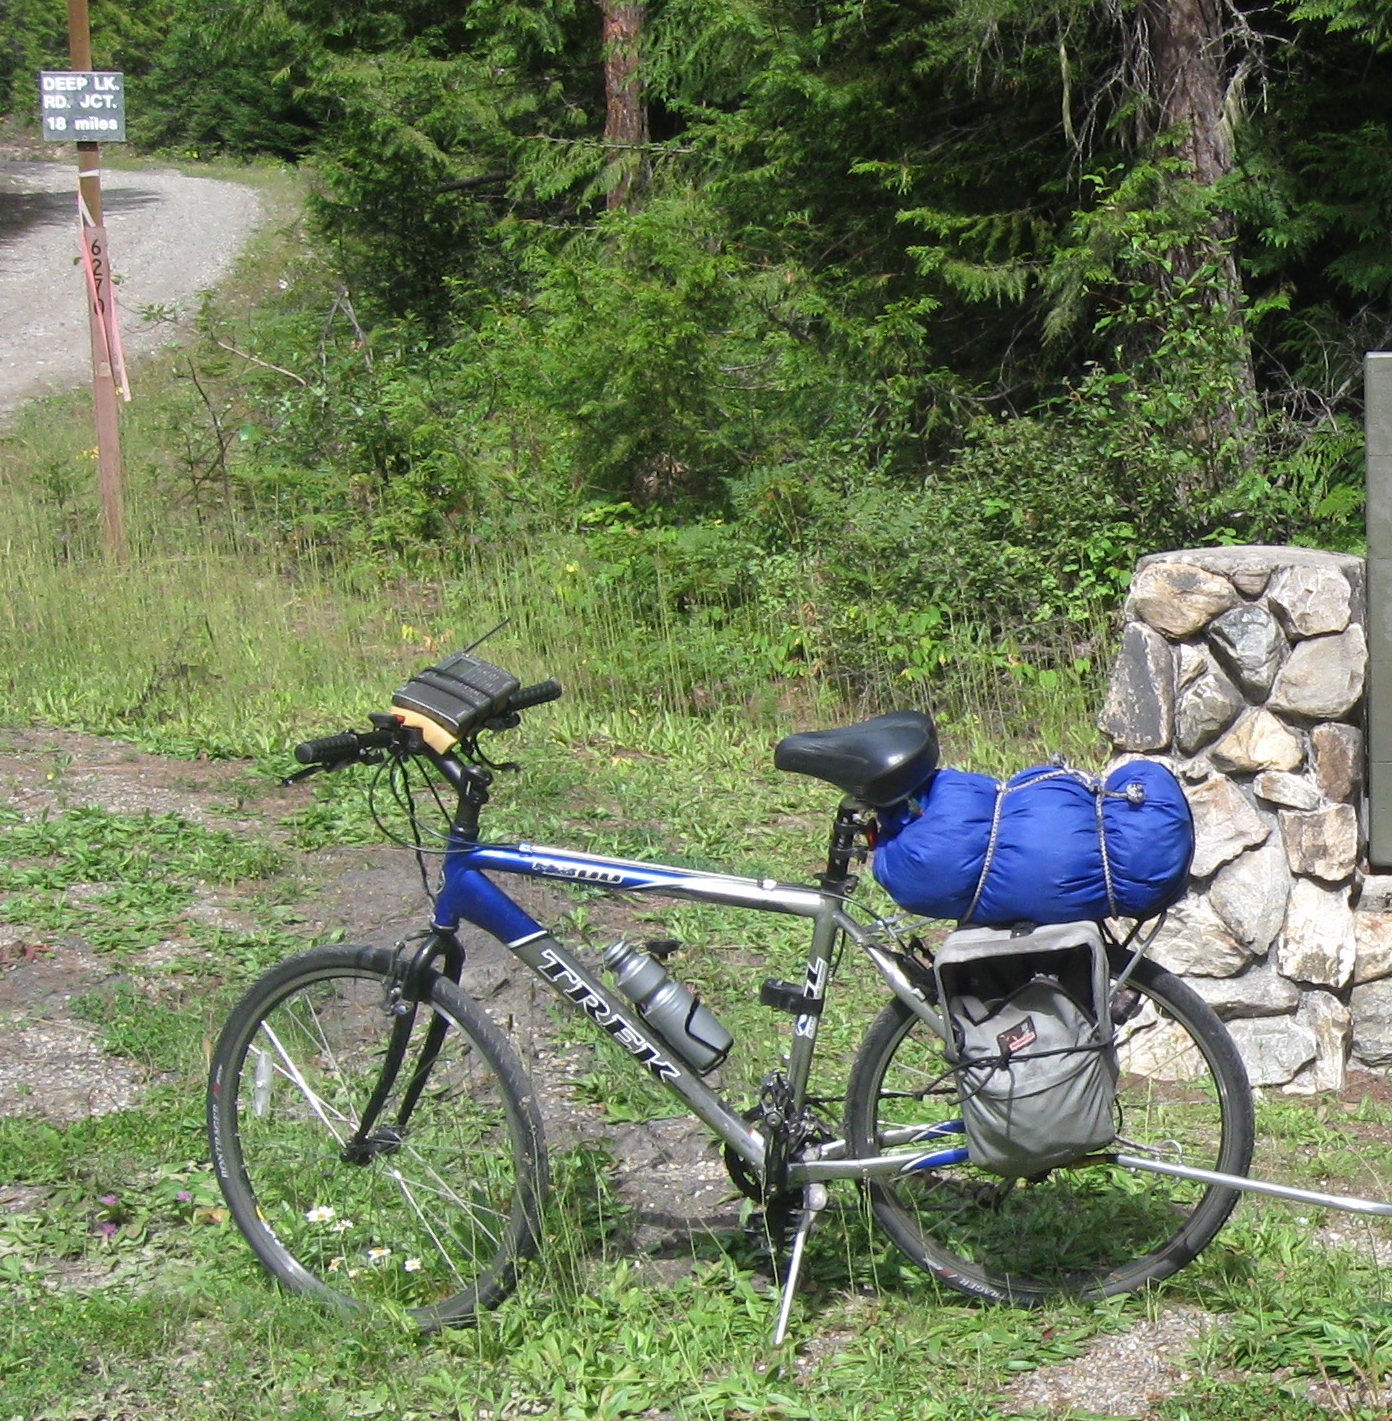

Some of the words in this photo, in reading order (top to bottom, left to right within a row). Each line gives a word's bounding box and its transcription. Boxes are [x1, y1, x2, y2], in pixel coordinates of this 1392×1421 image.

[43, 76, 88, 91] DEEP
[94, 76, 120, 91] LK.
[43, 94, 71, 109] RD.
[80, 94, 118, 109] JCT.
[46, 116, 67, 131] 18
[74, 115, 118, 131] miles
[537, 948, 681, 1083] TREK
[212, 1103, 229, 1179] BONTRAGER
